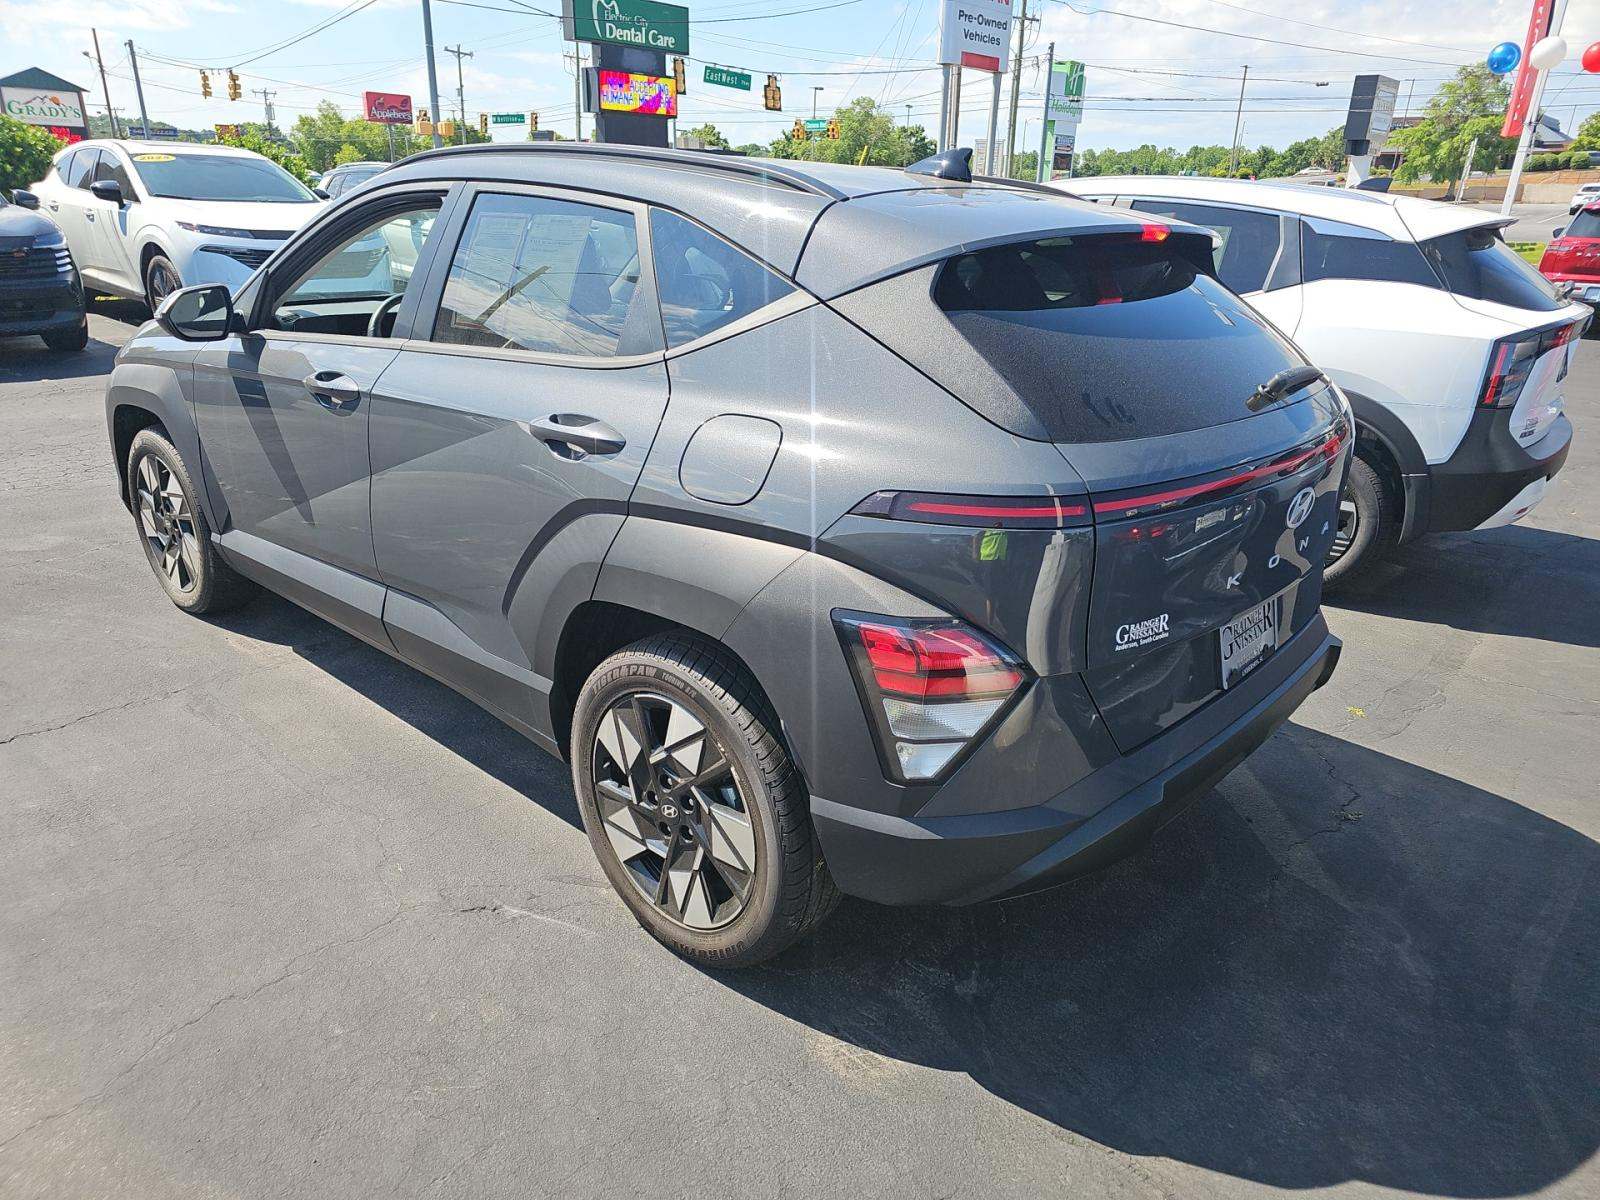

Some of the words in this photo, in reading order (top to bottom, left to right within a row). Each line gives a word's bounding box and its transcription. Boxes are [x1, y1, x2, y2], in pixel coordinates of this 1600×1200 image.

[958, 10, 1007, 30] Pre-Owned
[605, 23, 645, 43] Dental
[649, 30, 675, 48] Care
[963, 28, 1001, 46] Vehicles
[7, 99, 81, 118] GRADY'S
[1115, 613, 1170, 644] GRAINGER
[629, 665, 657, 677] PAW
